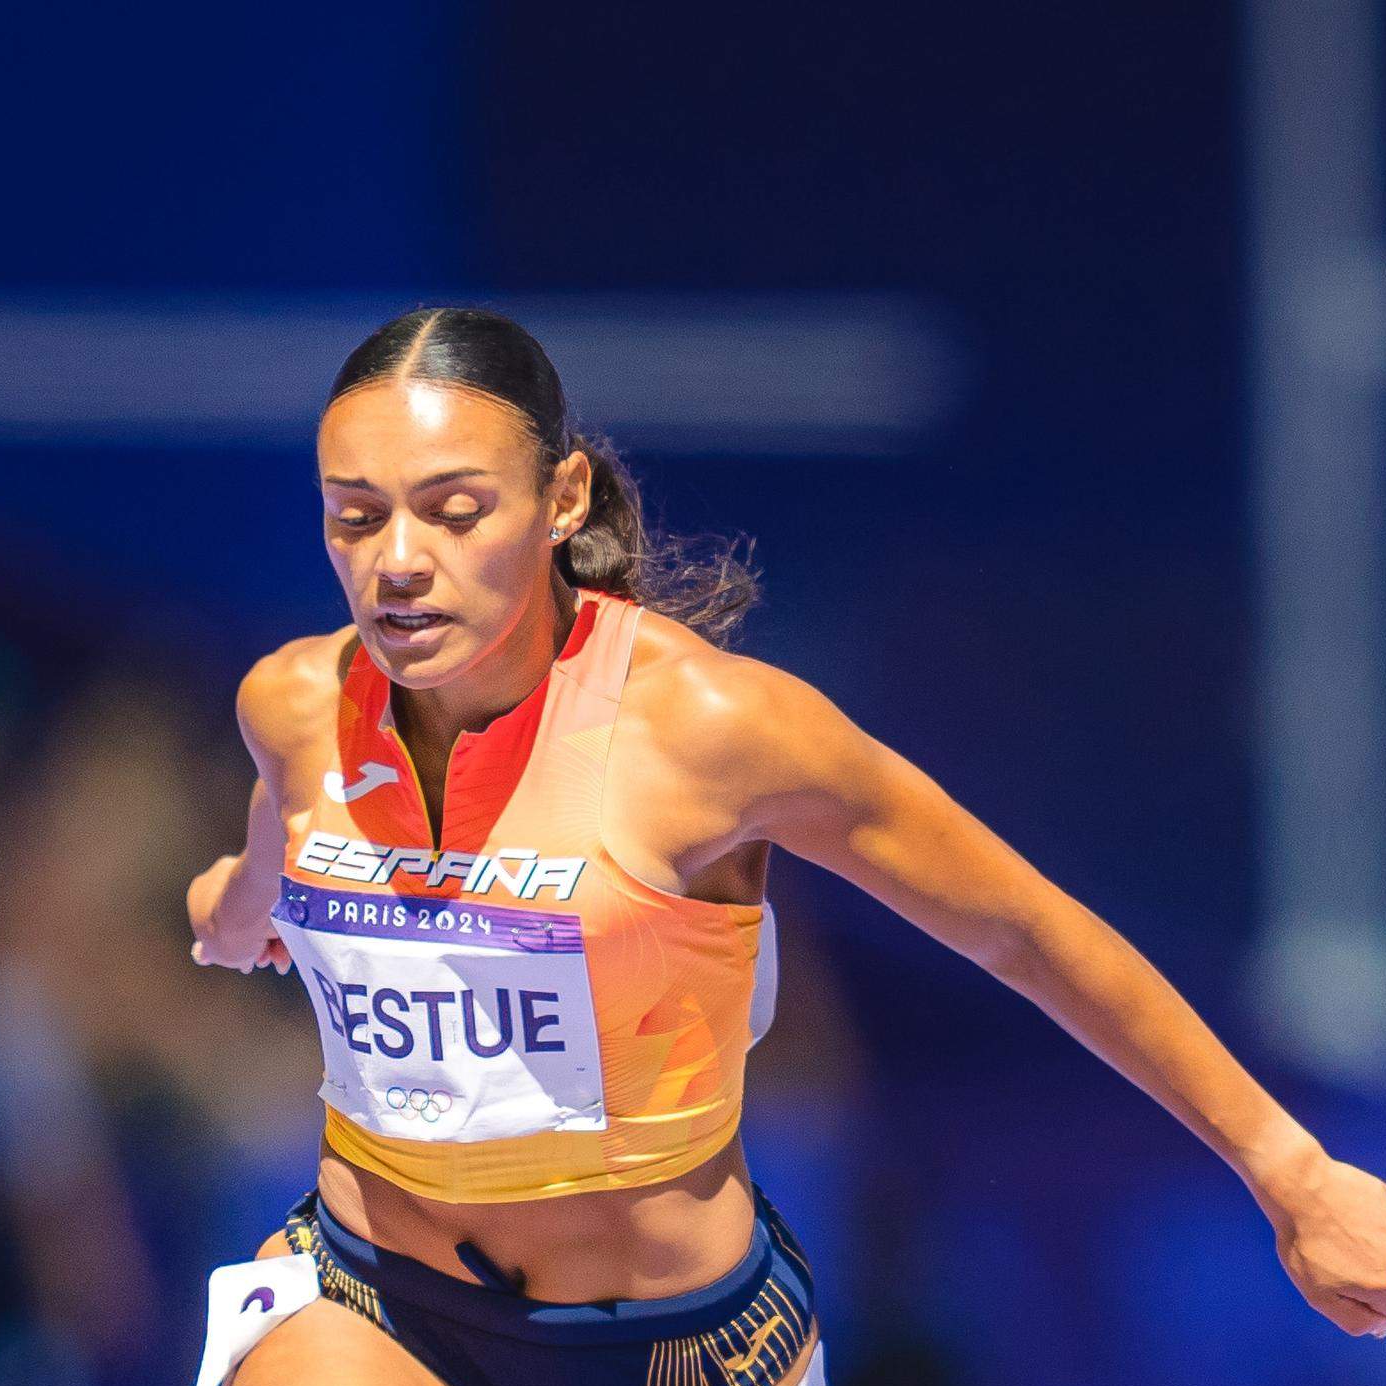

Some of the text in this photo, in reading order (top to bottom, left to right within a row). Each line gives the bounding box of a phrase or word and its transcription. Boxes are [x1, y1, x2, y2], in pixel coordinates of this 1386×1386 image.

[297, 831, 587, 900] ESPAÑA
[327, 900, 492, 935] PARIS 2024
[311, 967, 566, 1061] BESTUE
